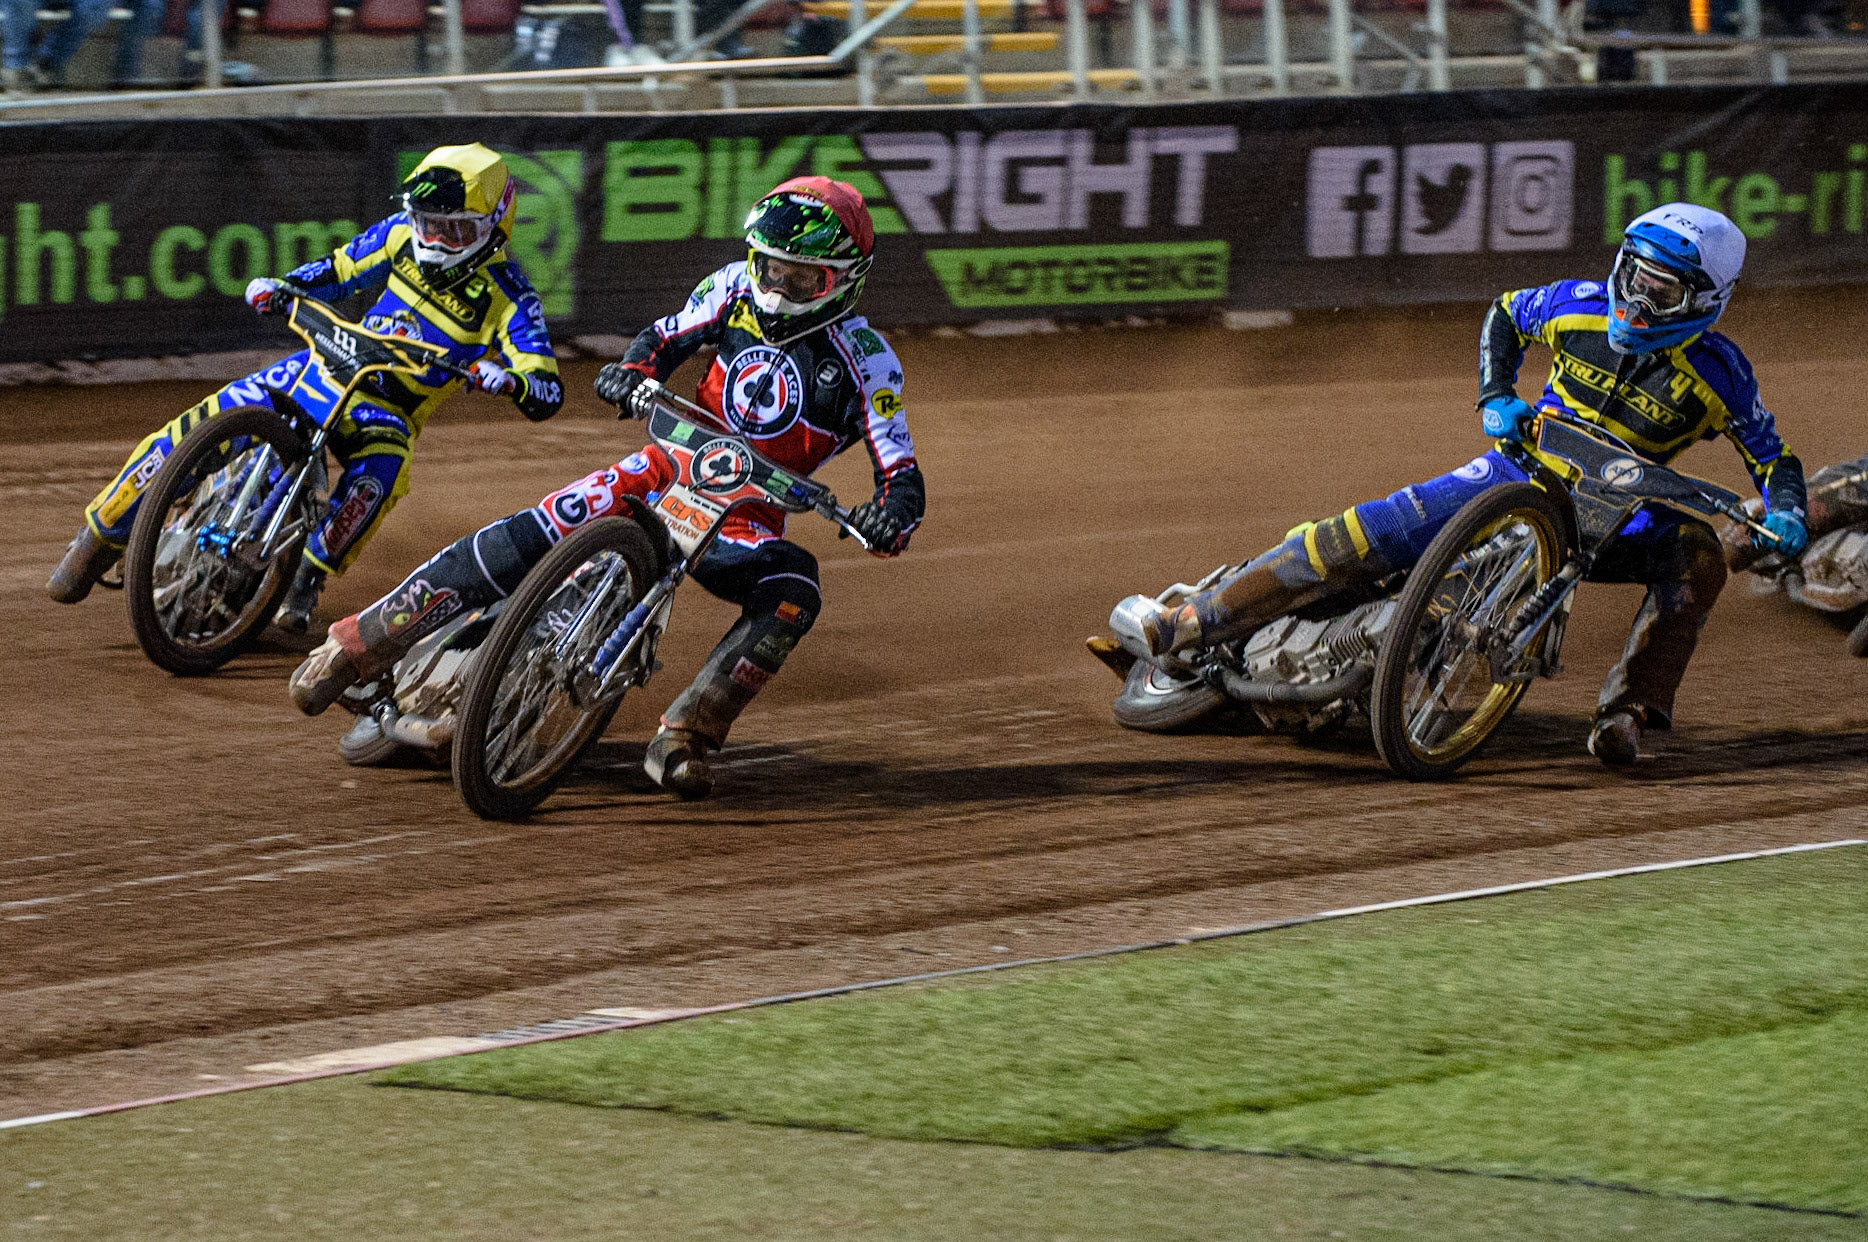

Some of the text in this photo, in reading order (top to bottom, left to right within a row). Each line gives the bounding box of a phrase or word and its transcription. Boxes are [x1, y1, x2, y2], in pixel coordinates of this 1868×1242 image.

[0, 202, 362, 306] ht.com
[962, 252, 1218, 296] MOTORBIKE
[735, 351, 799, 405] BELLE VE ACES
[134, 453, 163, 490] JCB
